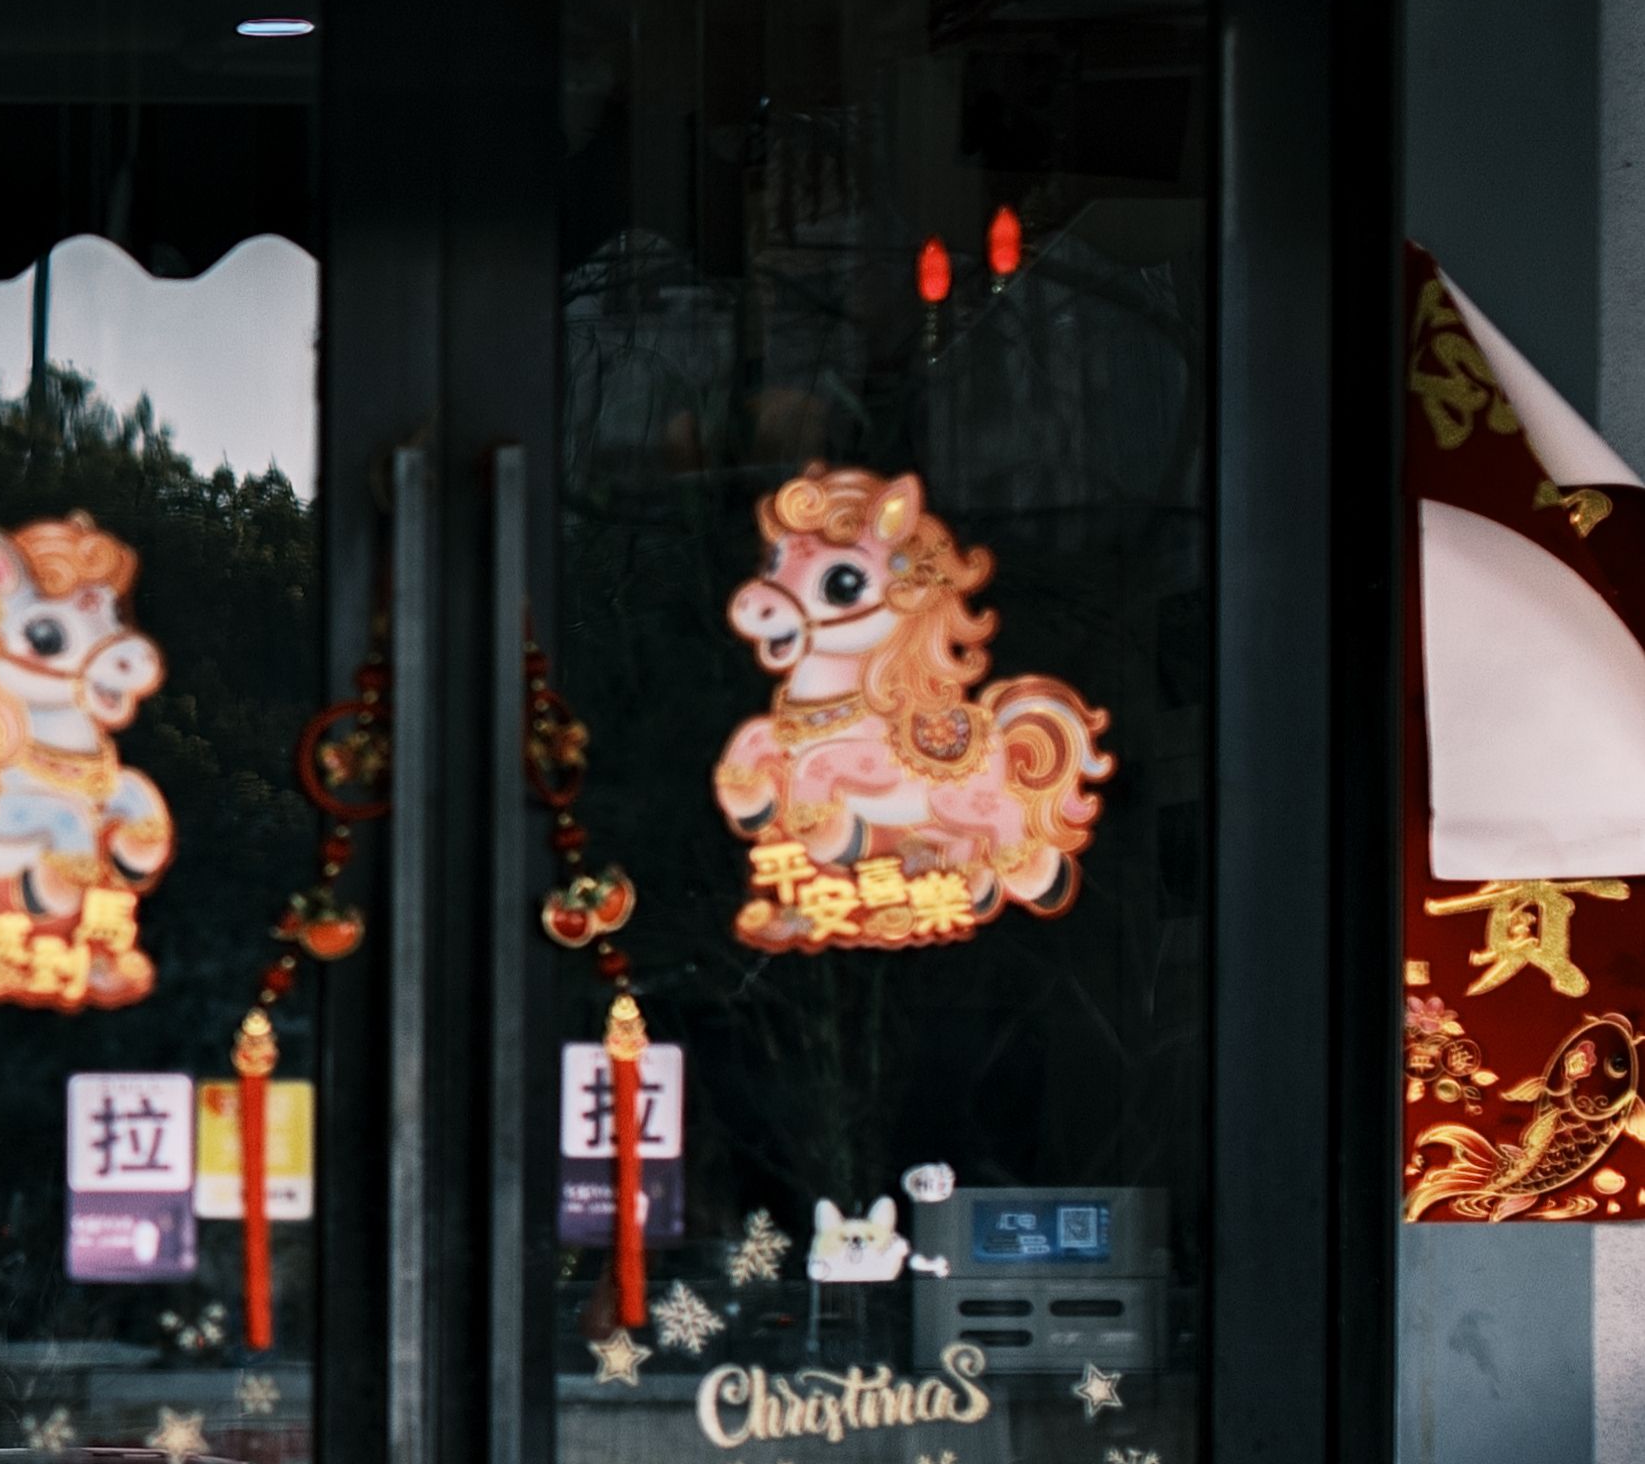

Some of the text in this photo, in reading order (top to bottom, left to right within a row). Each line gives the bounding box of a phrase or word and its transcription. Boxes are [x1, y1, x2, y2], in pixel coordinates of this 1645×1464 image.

[90, 1096, 172, 1178] 拉
[582, 1068, 664, 1146] 拉
[697, 1342, 990, 1450] Christmas
